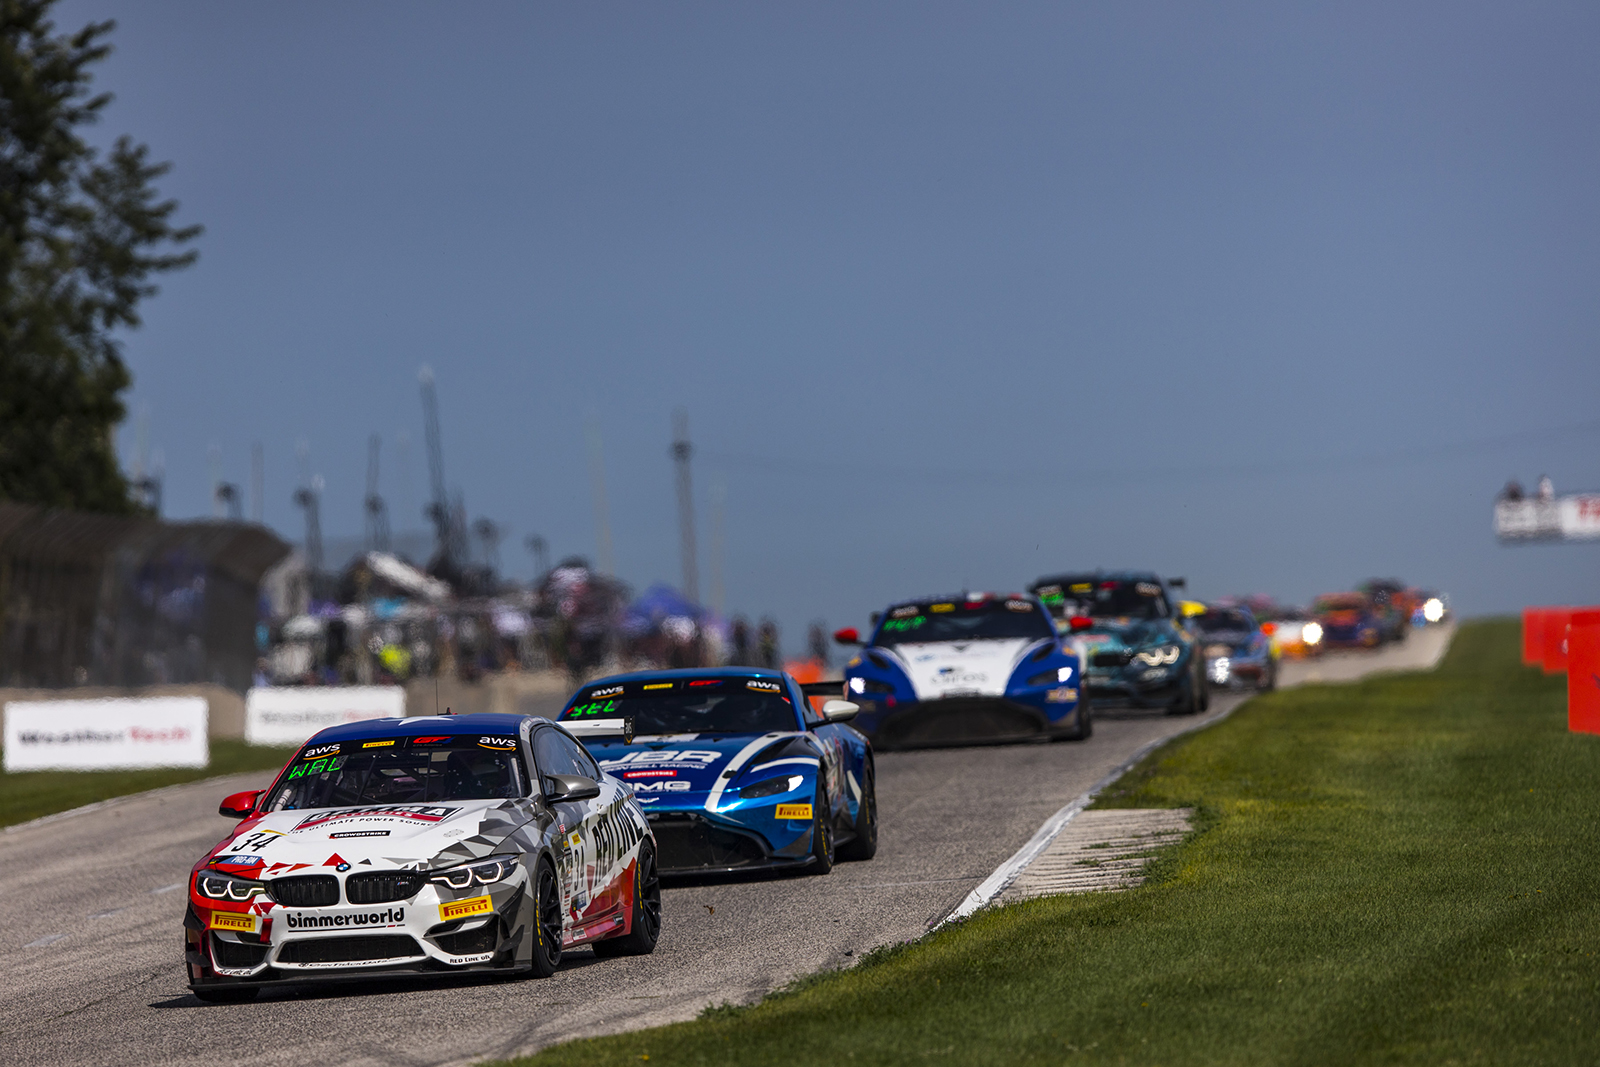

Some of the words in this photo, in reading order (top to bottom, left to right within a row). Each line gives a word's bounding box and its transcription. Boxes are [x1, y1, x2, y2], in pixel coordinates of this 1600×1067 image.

[592, 686, 624, 698] aws
[747, 680, 780, 691] aws
[479, 736, 516, 747] aws
[304, 743, 341, 757] aws
[599, 750, 722, 765] JBR
[288, 757, 342, 780] WAL
[779, 807, 809, 816] PIRELLI
[309, 819, 355, 832] ULTIMATE
[231, 833, 282, 852] 34
[443, 899, 488, 917] PIRELLI
[214, 914, 252, 929] PIRELLI
[286, 907, 405, 928] bimmerworld
